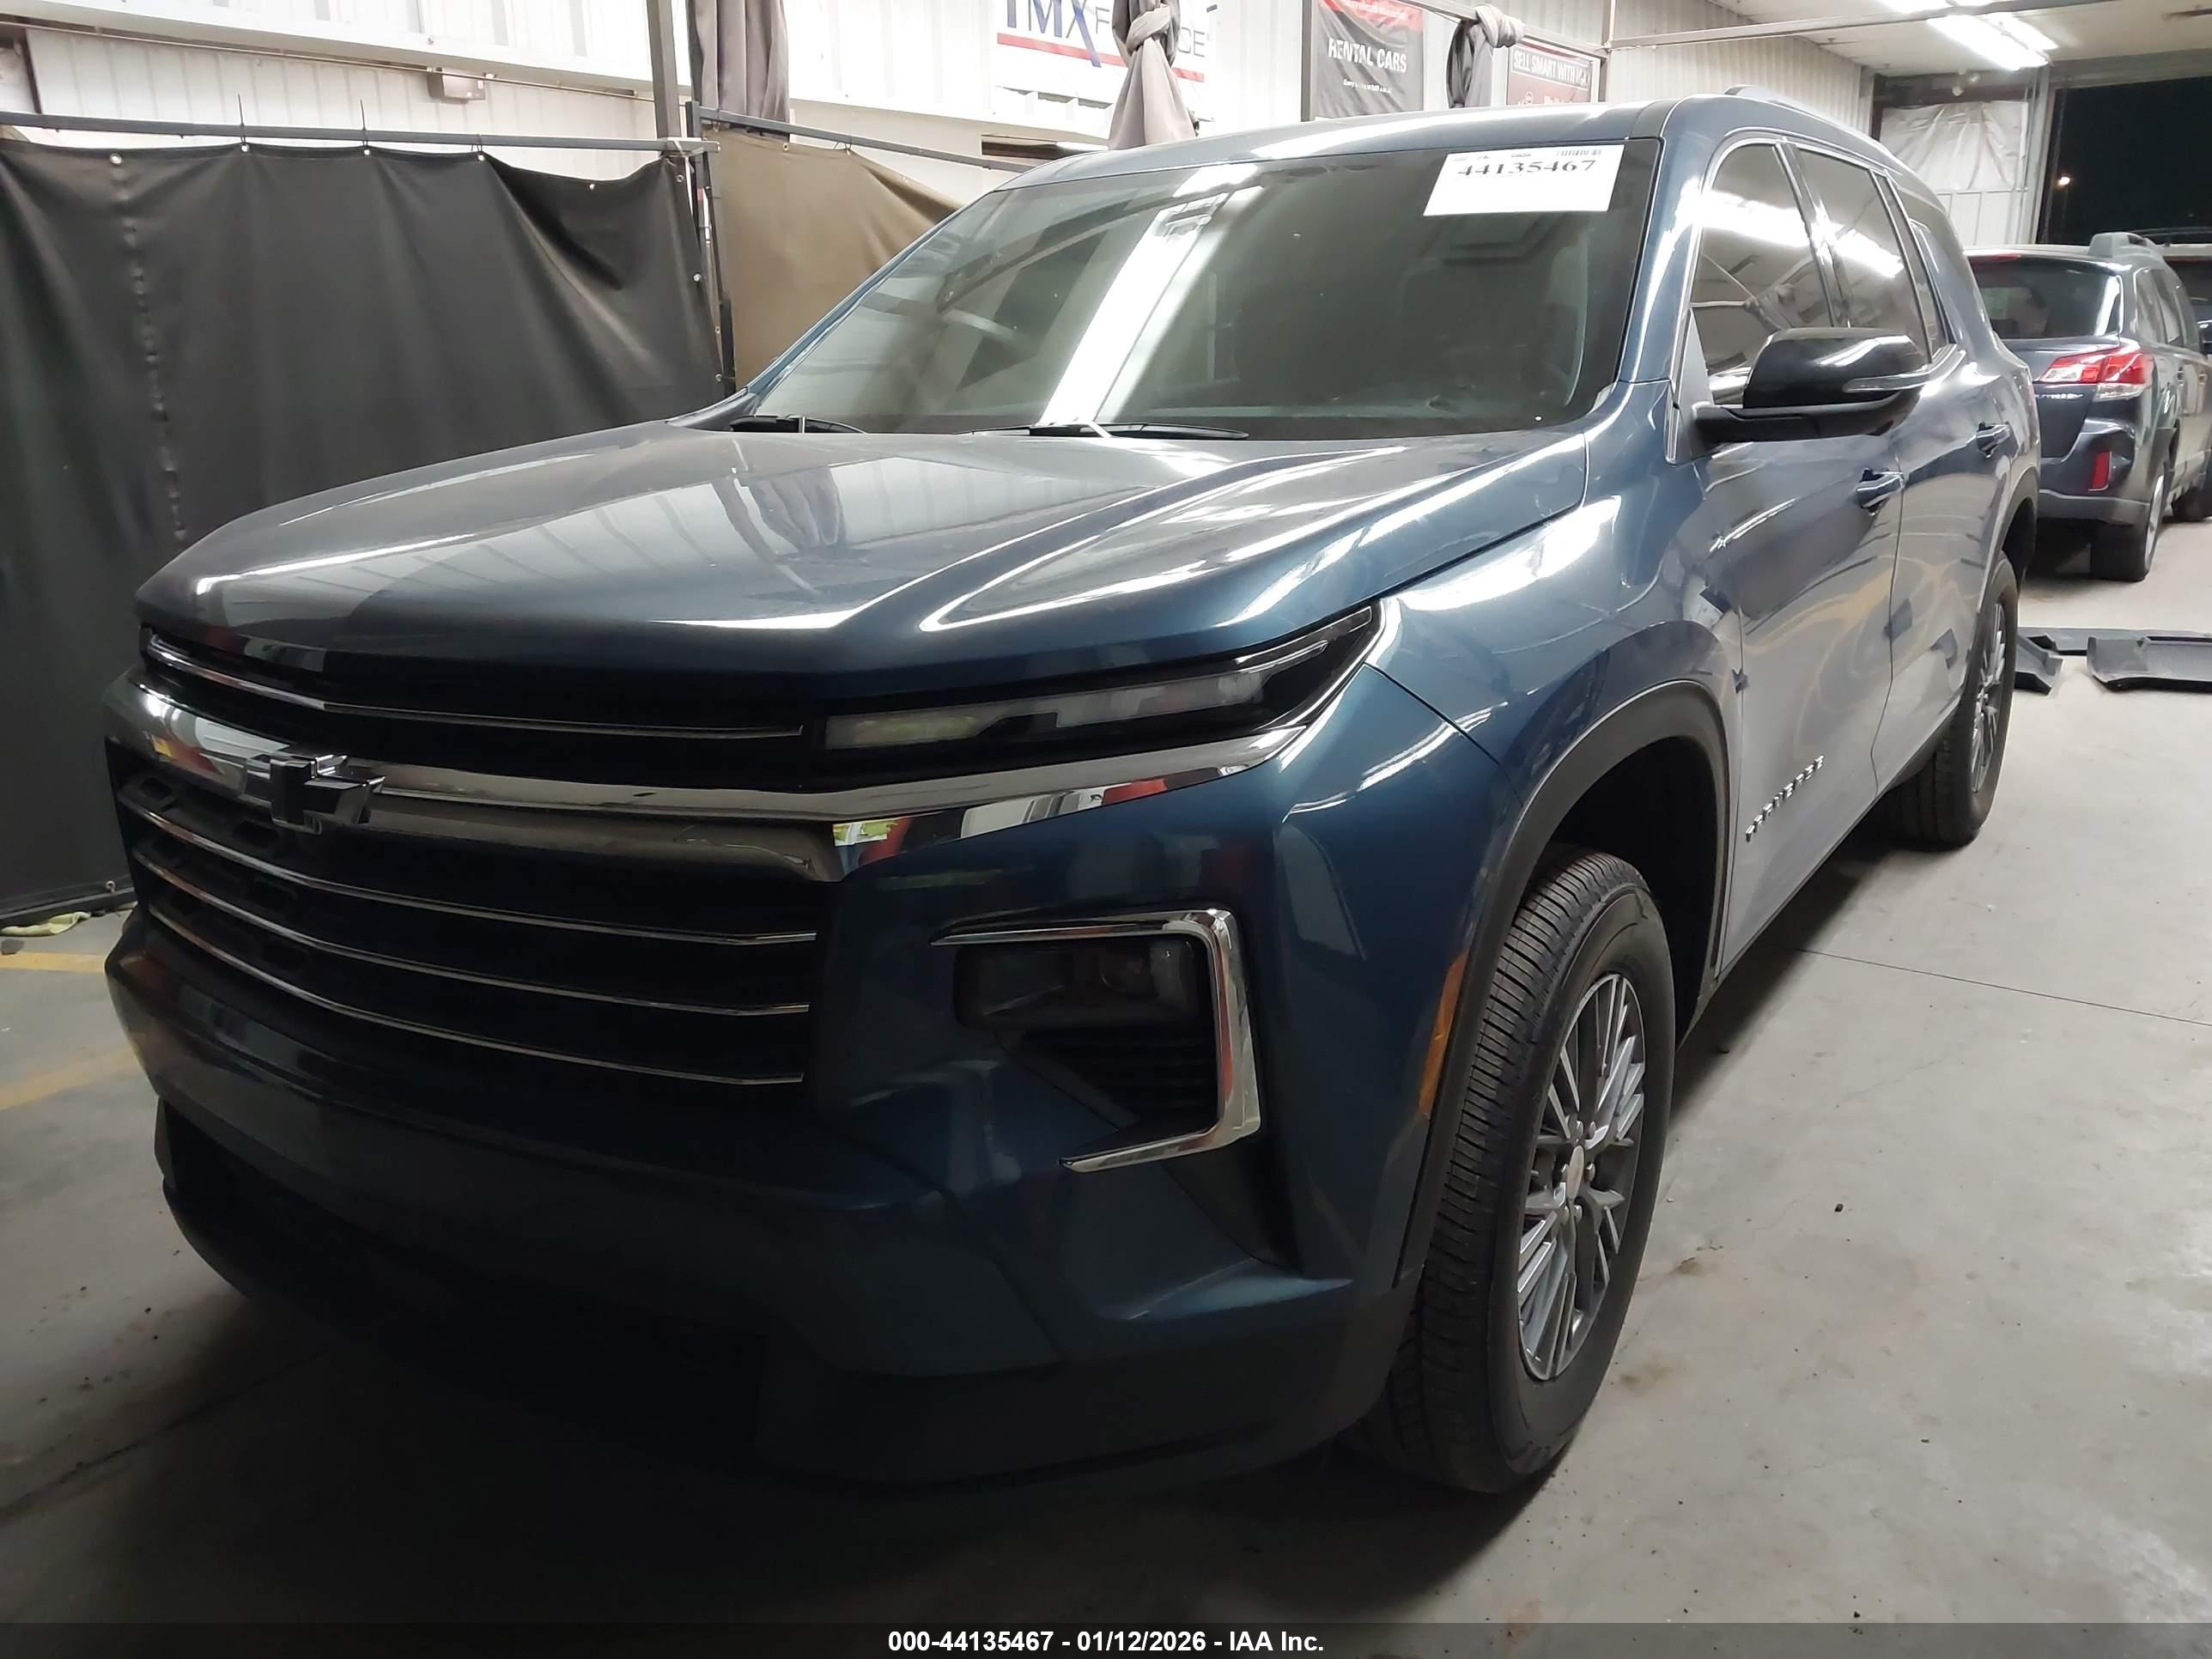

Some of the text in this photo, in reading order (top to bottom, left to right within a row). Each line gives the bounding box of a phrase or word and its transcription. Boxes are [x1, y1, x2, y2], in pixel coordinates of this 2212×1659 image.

[1328, 37, 1407, 73] RENTAL CARS
[1514, 50, 1530, 71] SELL
[1532, 55, 1557, 78] SMART
[1558, 63, 1576, 83] WITH
[1457, 160, 1596, 176] 44135467
